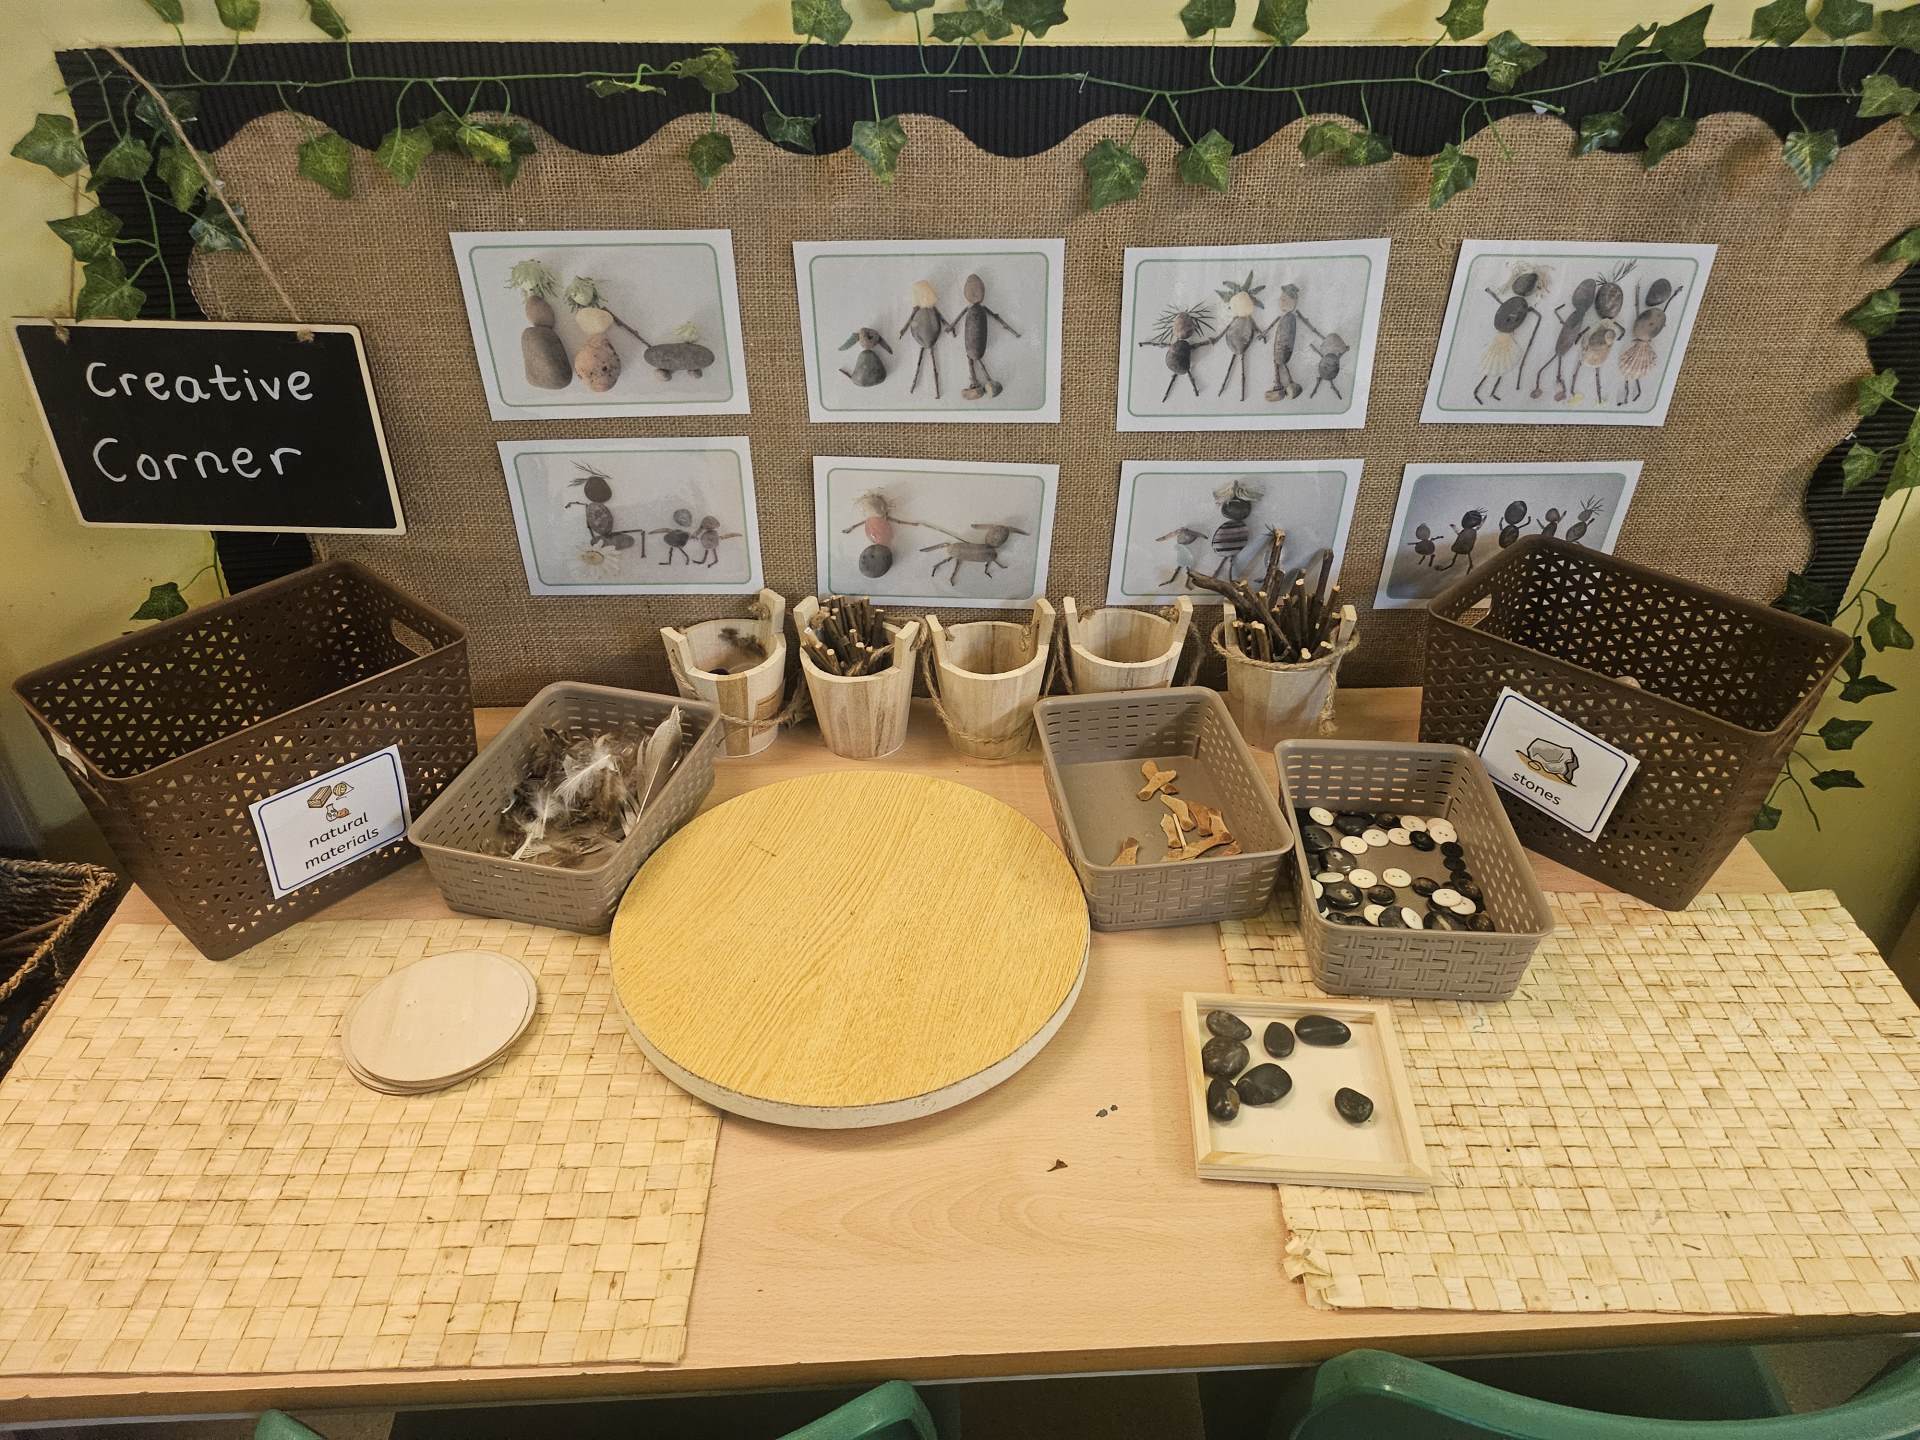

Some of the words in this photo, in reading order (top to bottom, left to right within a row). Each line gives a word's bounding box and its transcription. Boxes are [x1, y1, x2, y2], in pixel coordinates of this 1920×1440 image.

[86, 362, 313, 403] Creative
[92, 437, 302, 482] Corner
[1511, 771, 1562, 806] stones
[305, 827, 380, 870] materials
[309, 812, 369, 848] natural
